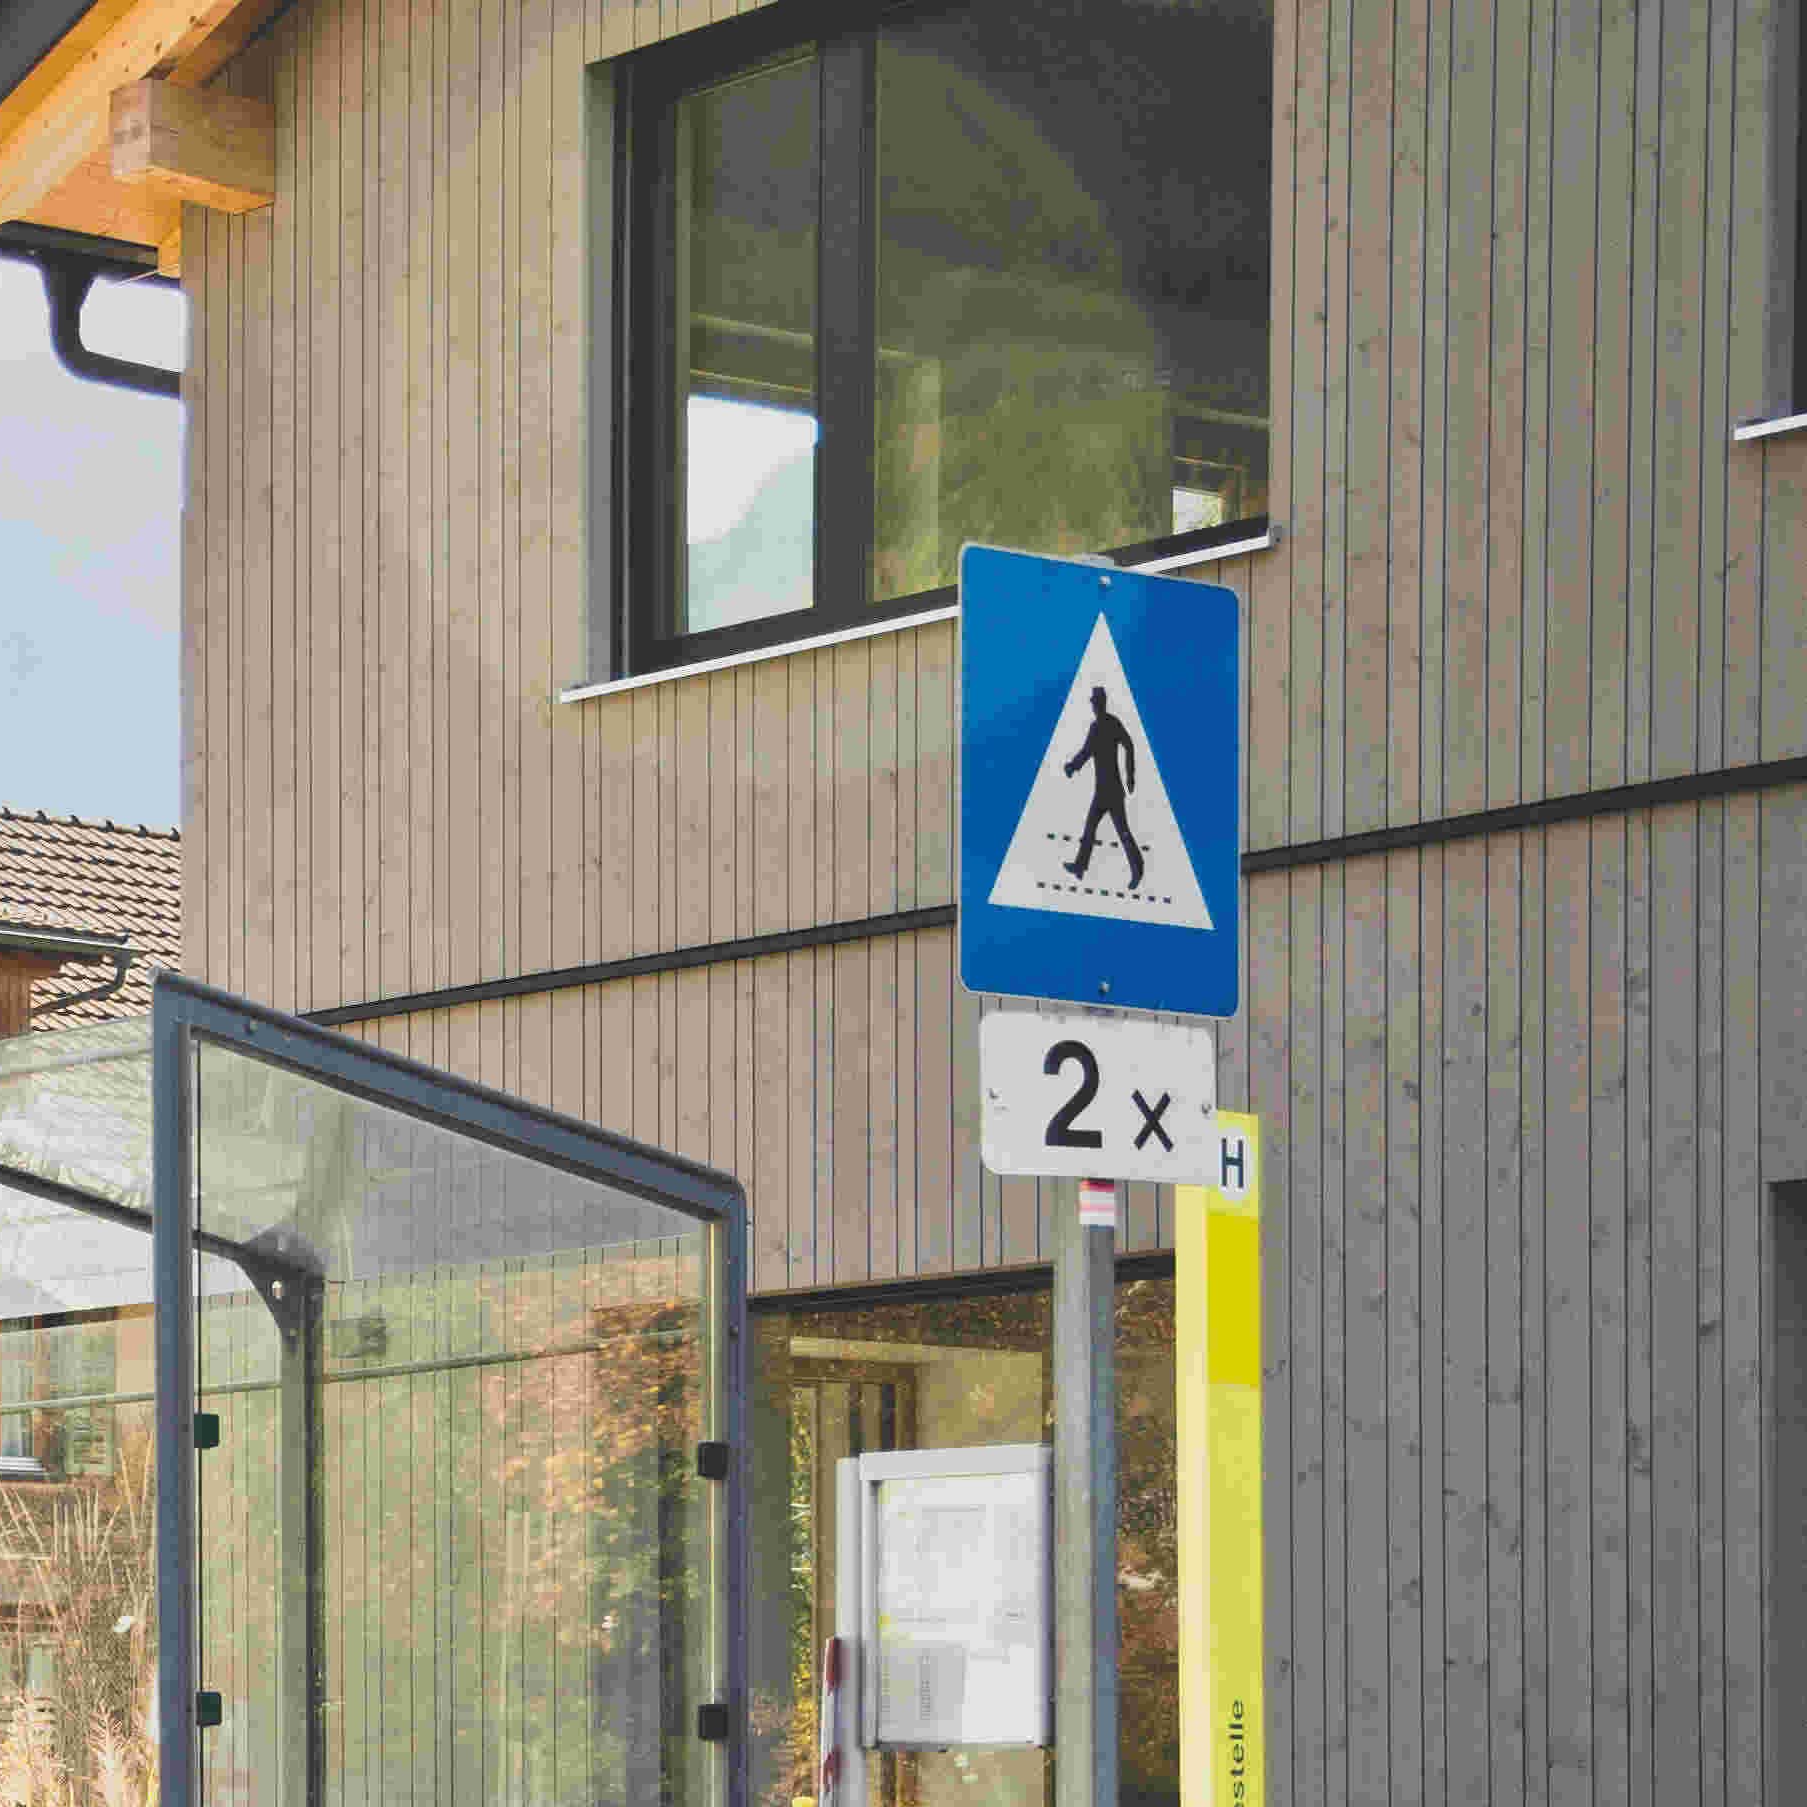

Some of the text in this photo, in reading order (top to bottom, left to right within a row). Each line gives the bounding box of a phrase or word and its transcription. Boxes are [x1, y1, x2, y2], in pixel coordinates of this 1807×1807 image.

[1042, 1039, 1174, 1152] 2 x
[1220, 1137, 1244, 1189] H
